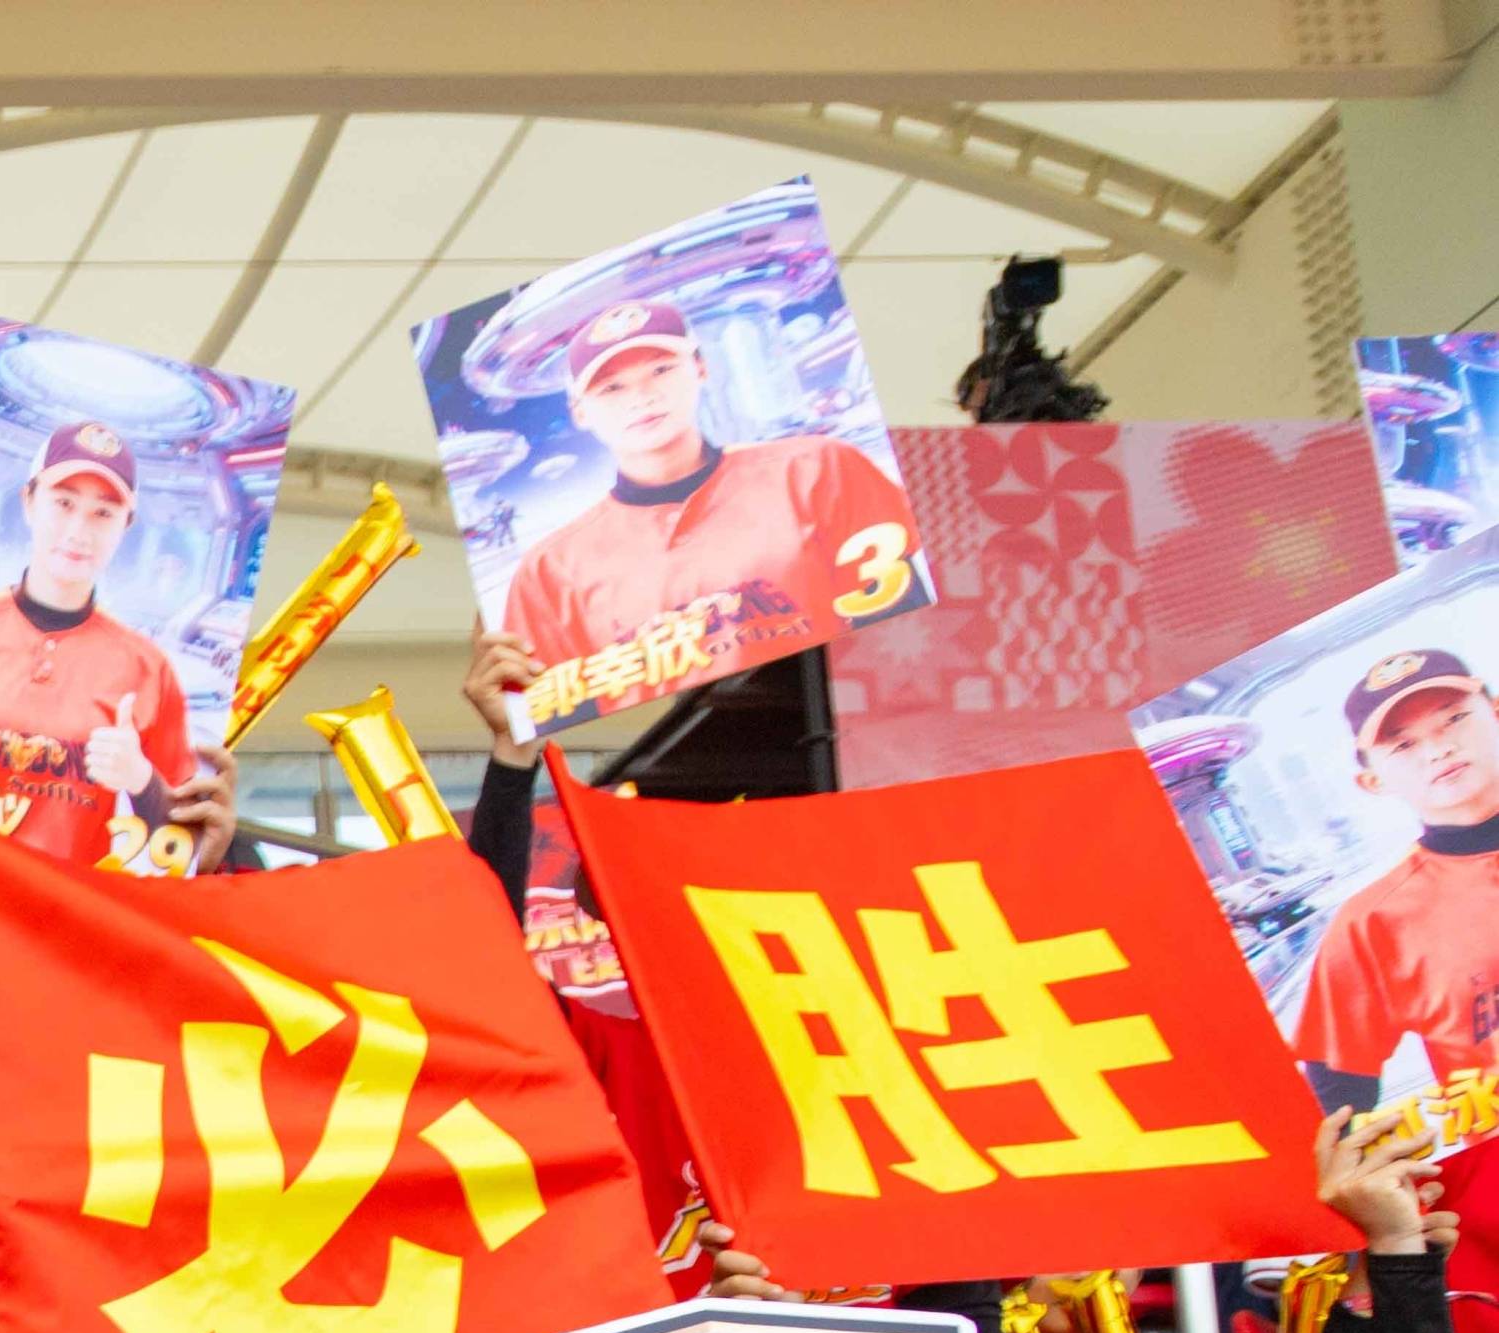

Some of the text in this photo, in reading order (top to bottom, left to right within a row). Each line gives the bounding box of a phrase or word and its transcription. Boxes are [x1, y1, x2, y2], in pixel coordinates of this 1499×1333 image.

[832, 519, 913, 619] 3
[94, 812, 196, 877] 29
[684, 860, 1269, 1199] 胜
